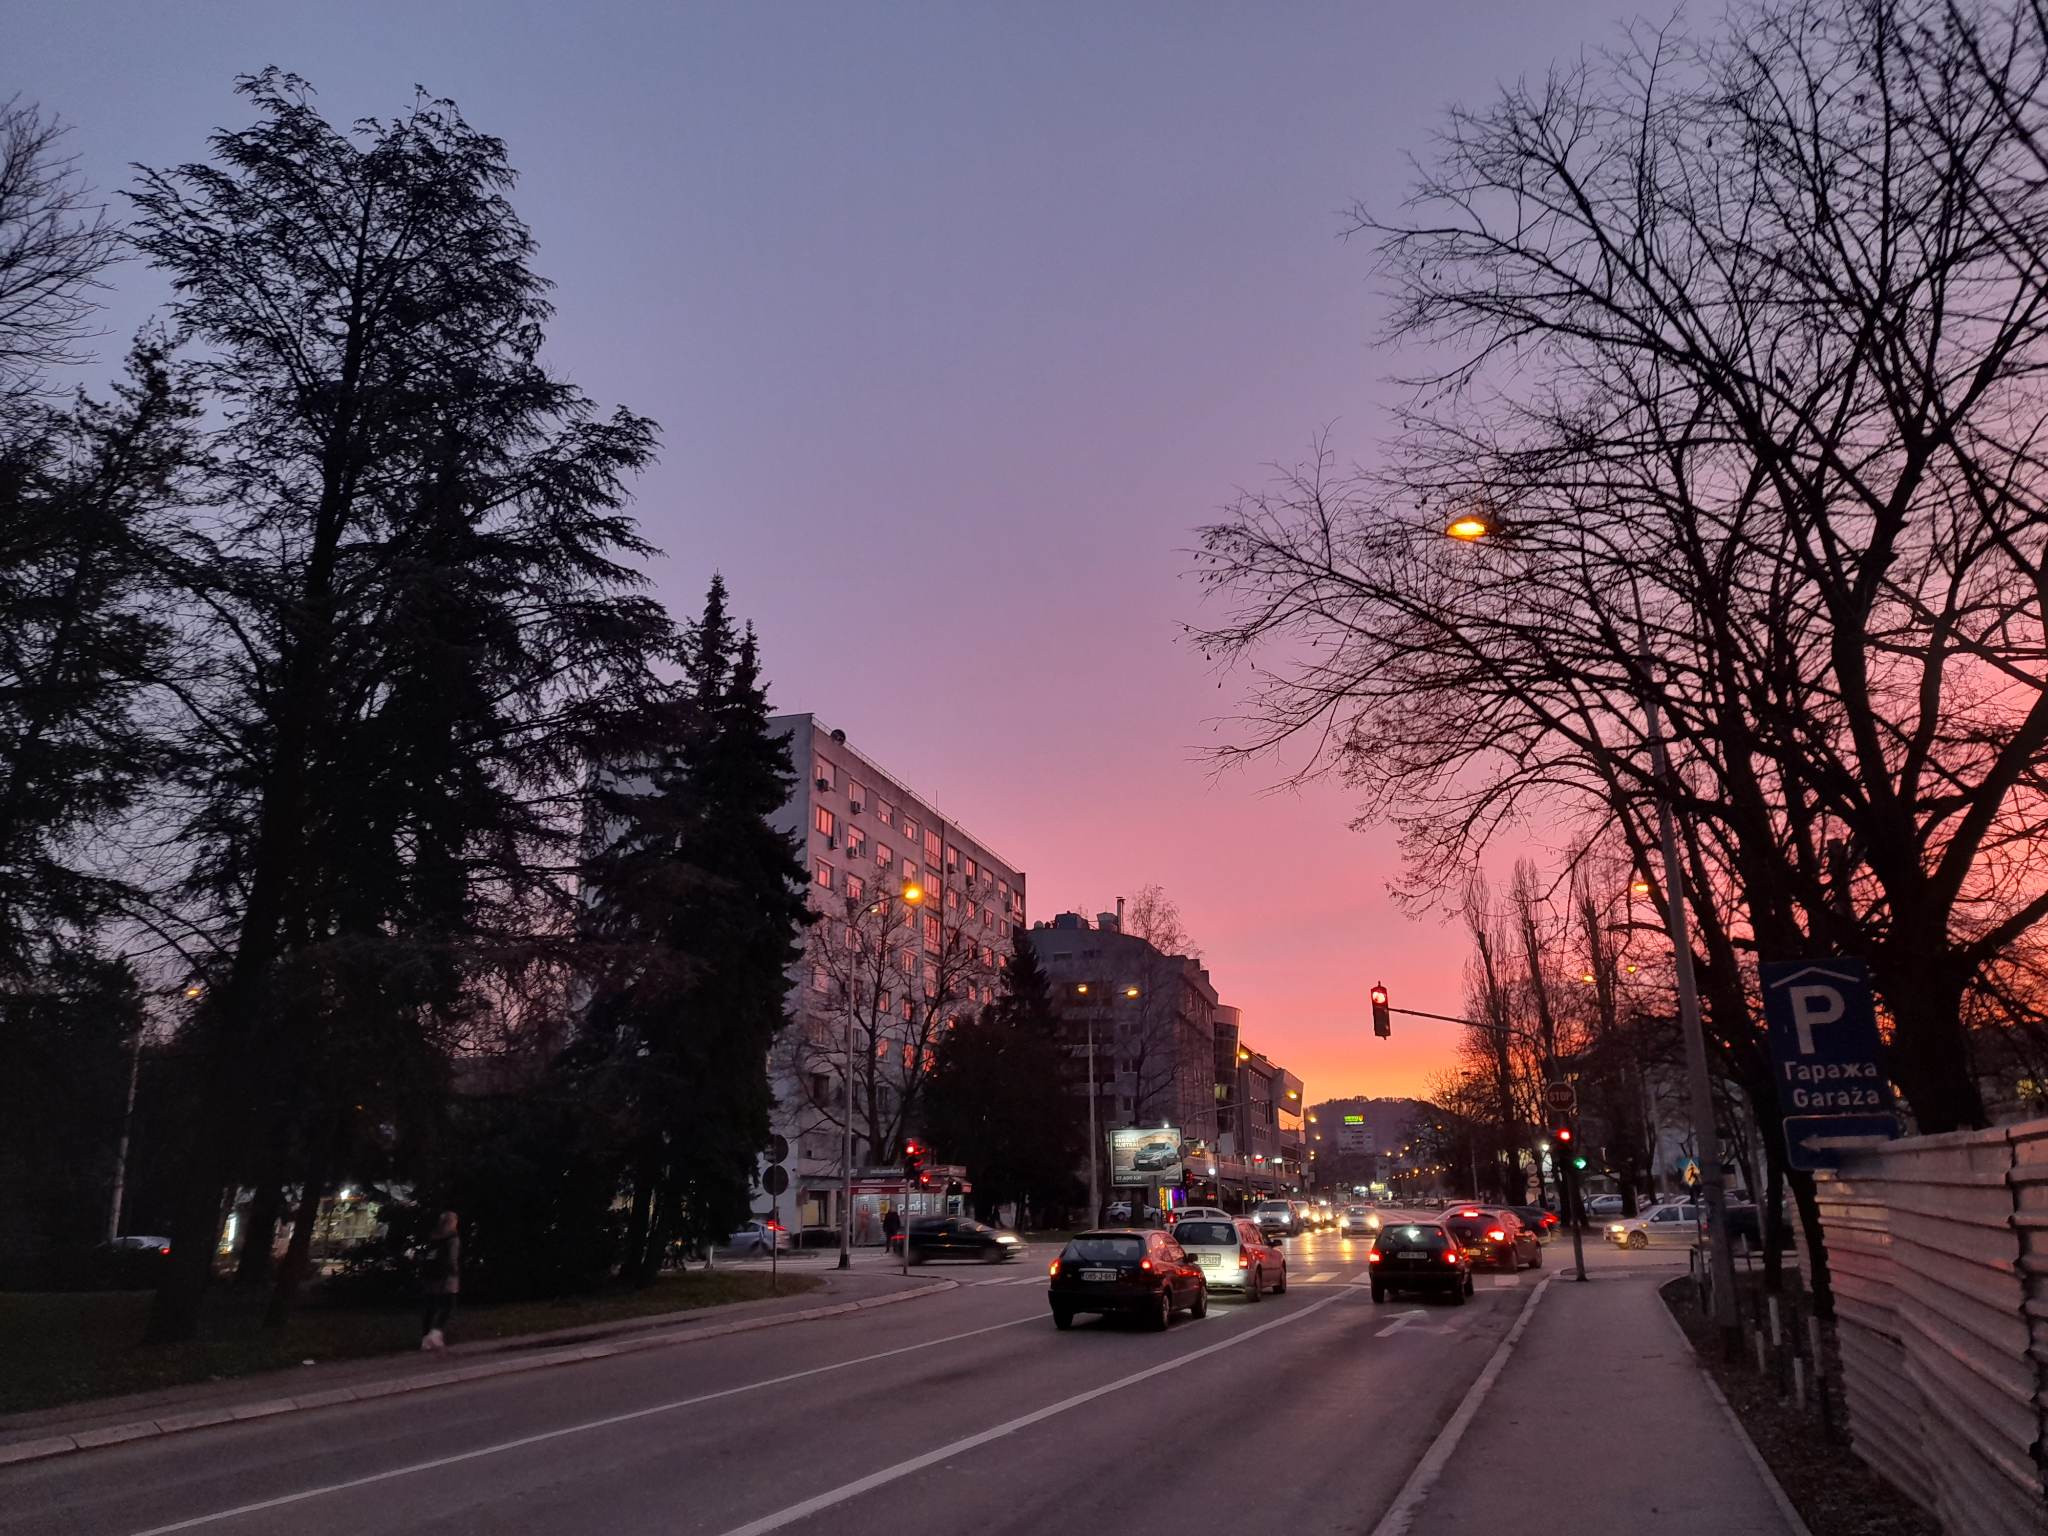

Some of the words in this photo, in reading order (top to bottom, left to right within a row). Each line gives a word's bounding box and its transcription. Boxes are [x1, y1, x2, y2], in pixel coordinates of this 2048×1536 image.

[1789, 984, 1846, 1055] P
[1784, 1061, 1878, 1084] Гаража
[1549, 1091, 1572, 1102] STOP
[1793, 1087, 1880, 1108] Garaža
